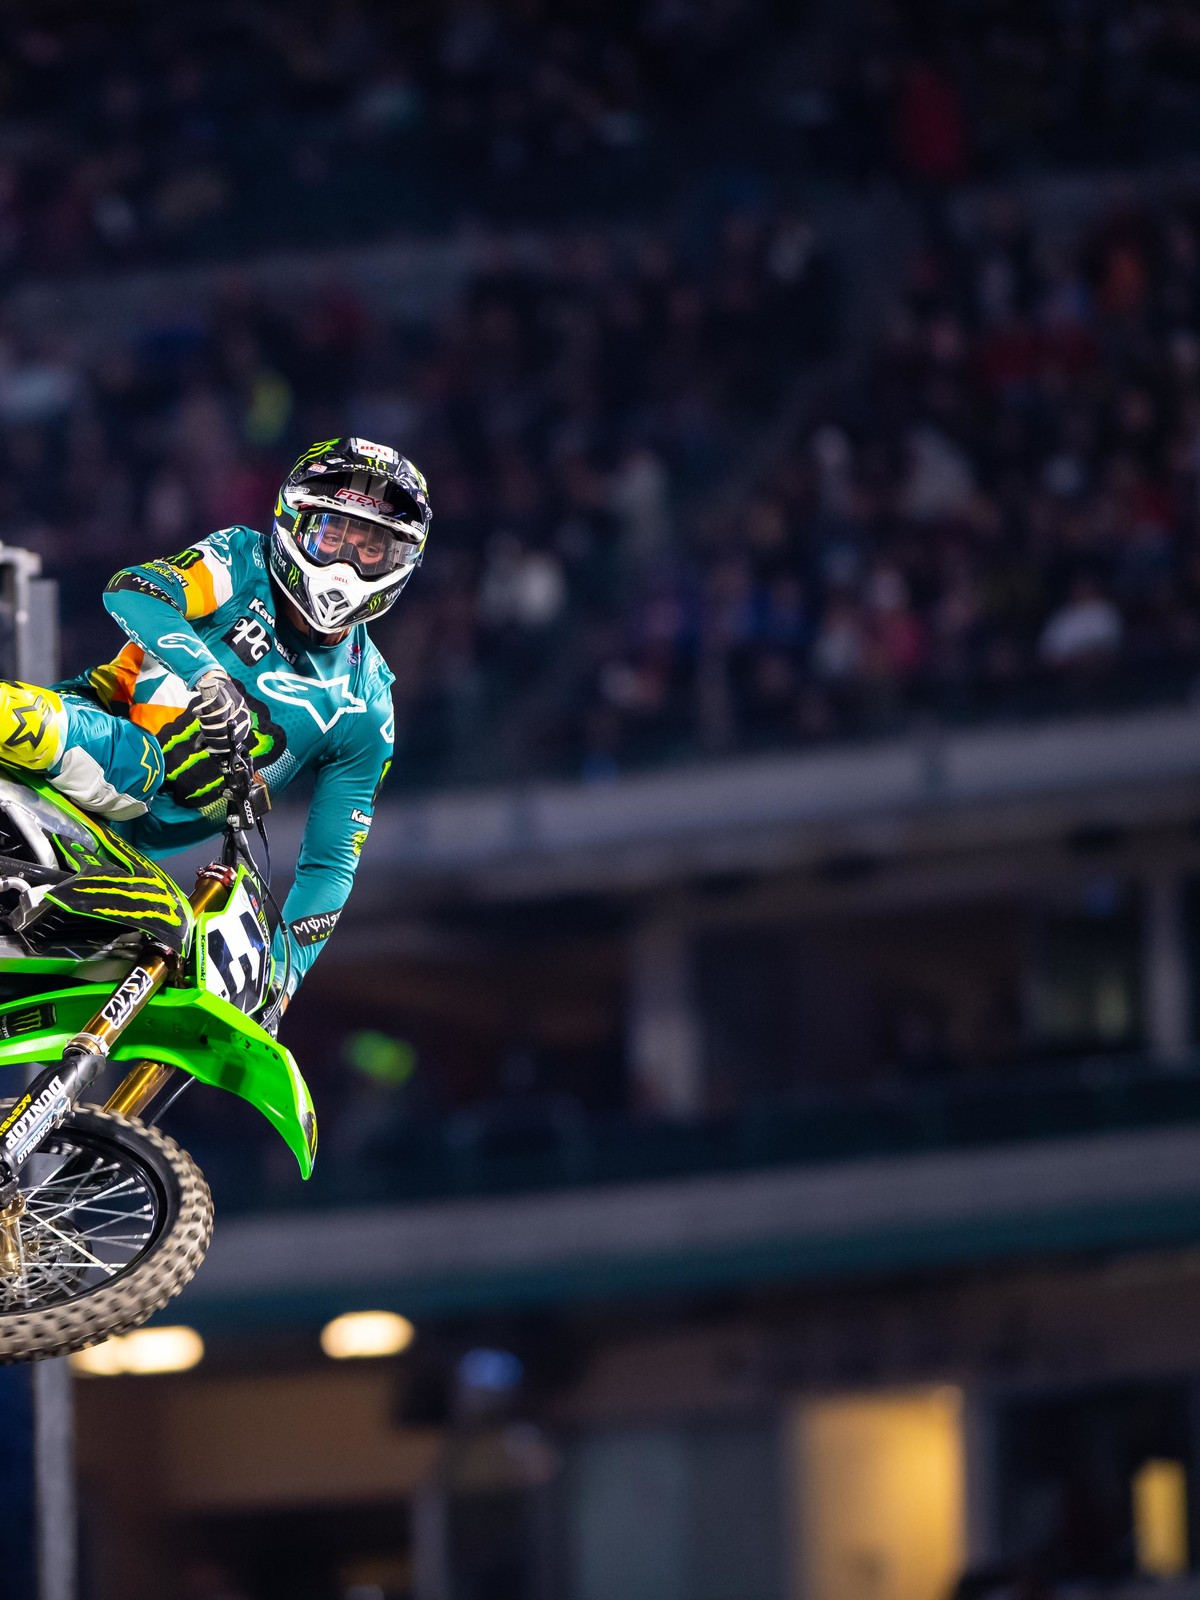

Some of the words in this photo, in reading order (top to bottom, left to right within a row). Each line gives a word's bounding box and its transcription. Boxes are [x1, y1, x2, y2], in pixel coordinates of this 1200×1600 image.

[335, 489, 380, 508] FLEX
[334, 575, 349, 585] BELL
[101, 966, 154, 1030] KYB
[5, 1075, 64, 1151] DUNLOP
